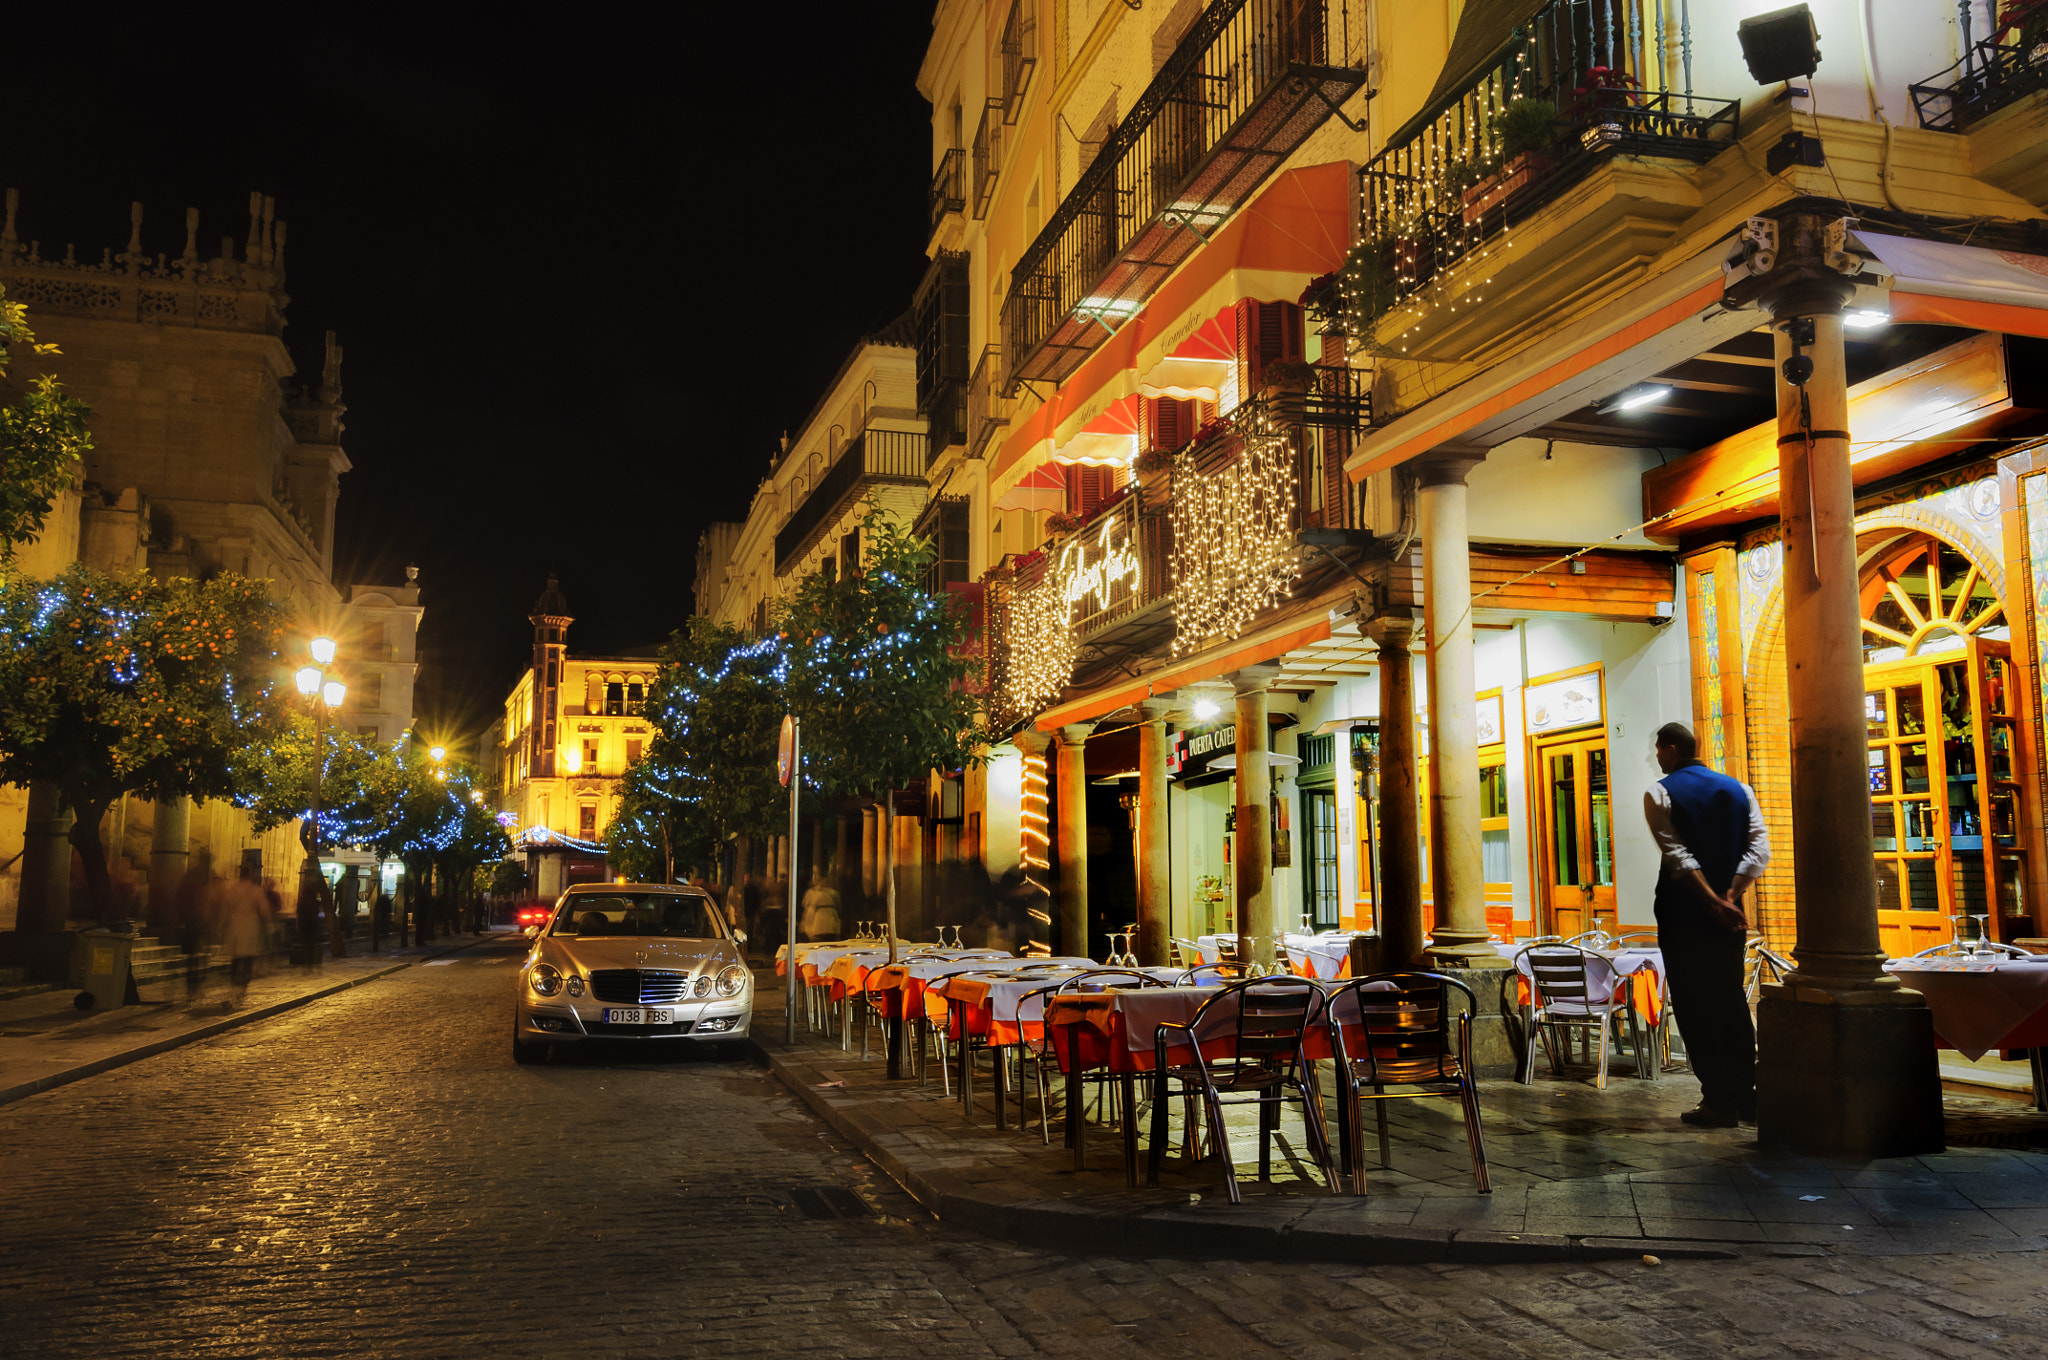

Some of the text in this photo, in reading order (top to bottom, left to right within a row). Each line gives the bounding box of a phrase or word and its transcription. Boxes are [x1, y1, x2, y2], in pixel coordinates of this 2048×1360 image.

[1160, 311, 1202, 354] Comedor
[1189, 726, 1236, 757] PUERTA CATED
[611, 1010, 668, 1022] 0138 FBS
